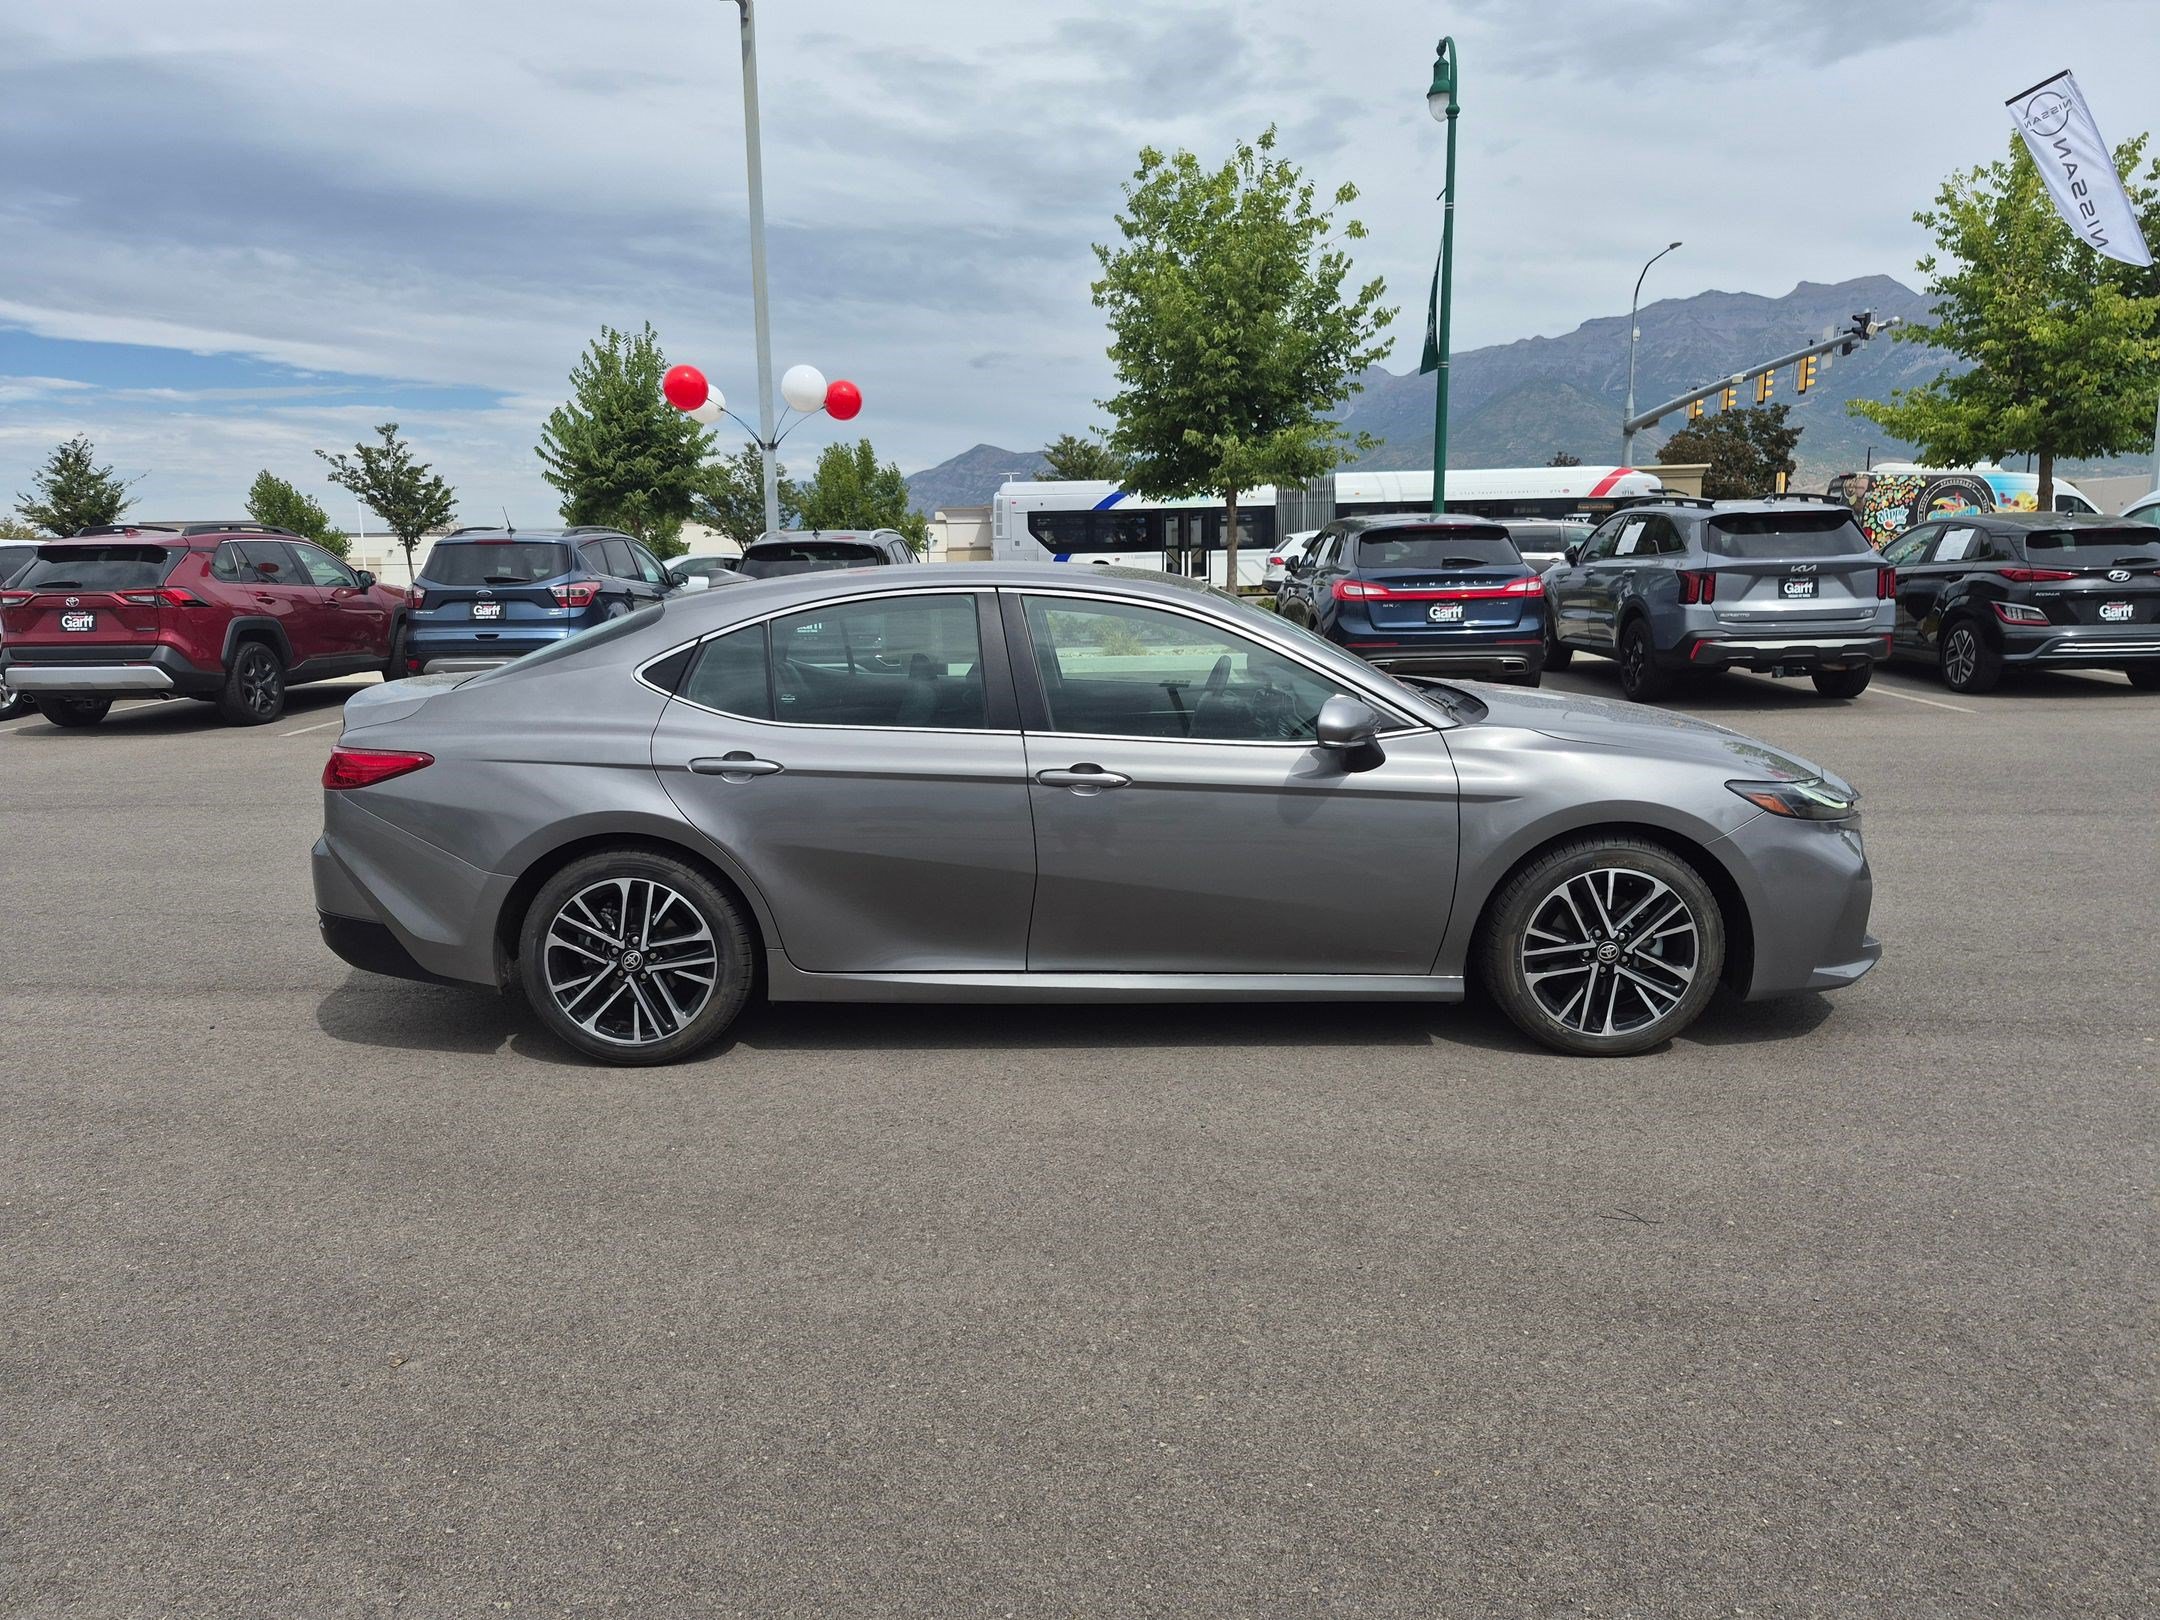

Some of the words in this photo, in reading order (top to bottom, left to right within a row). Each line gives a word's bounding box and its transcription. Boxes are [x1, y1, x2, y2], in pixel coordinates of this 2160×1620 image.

[1790, 564, 1817, 573] KIA
[1402, 580, 1492, 588] LINCOLN
[1783, 582, 1814, 594] Garff
[473, 605, 501, 615] Garff
[1429, 605, 1464, 618] Garff
[2099, 604, 2134, 618] Garff
[61, 615, 94, 628] Garff
